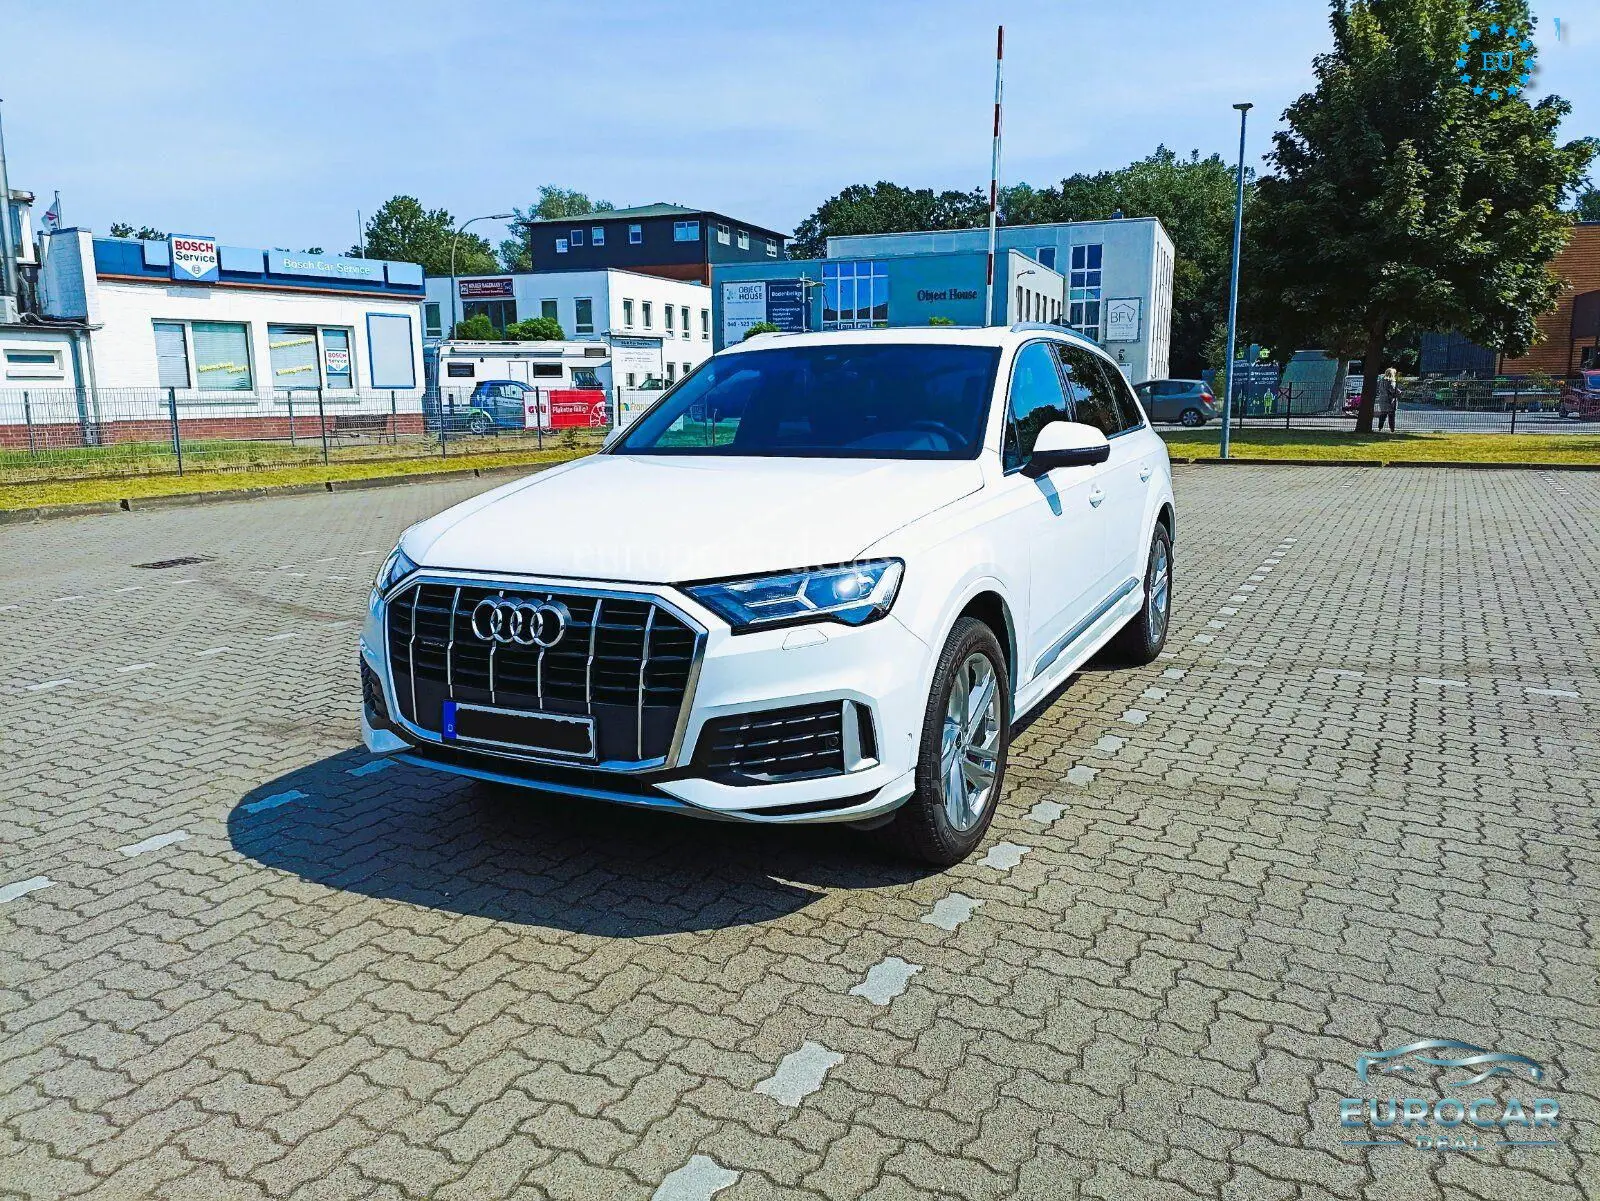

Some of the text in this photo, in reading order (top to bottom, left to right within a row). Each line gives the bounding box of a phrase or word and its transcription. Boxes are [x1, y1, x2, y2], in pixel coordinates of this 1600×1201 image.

[175, 241, 214, 253] BOSCH
[175, 251, 216, 264] Service
[283, 259, 371, 276] Bosch Car Service
[738, 285, 763, 294] OBJECT
[738, 293, 763, 301] HOUSE
[916, 289, 978, 303] Object House
[1110, 310, 1136, 324] BFV
[327, 352, 348, 360] BOSCH
